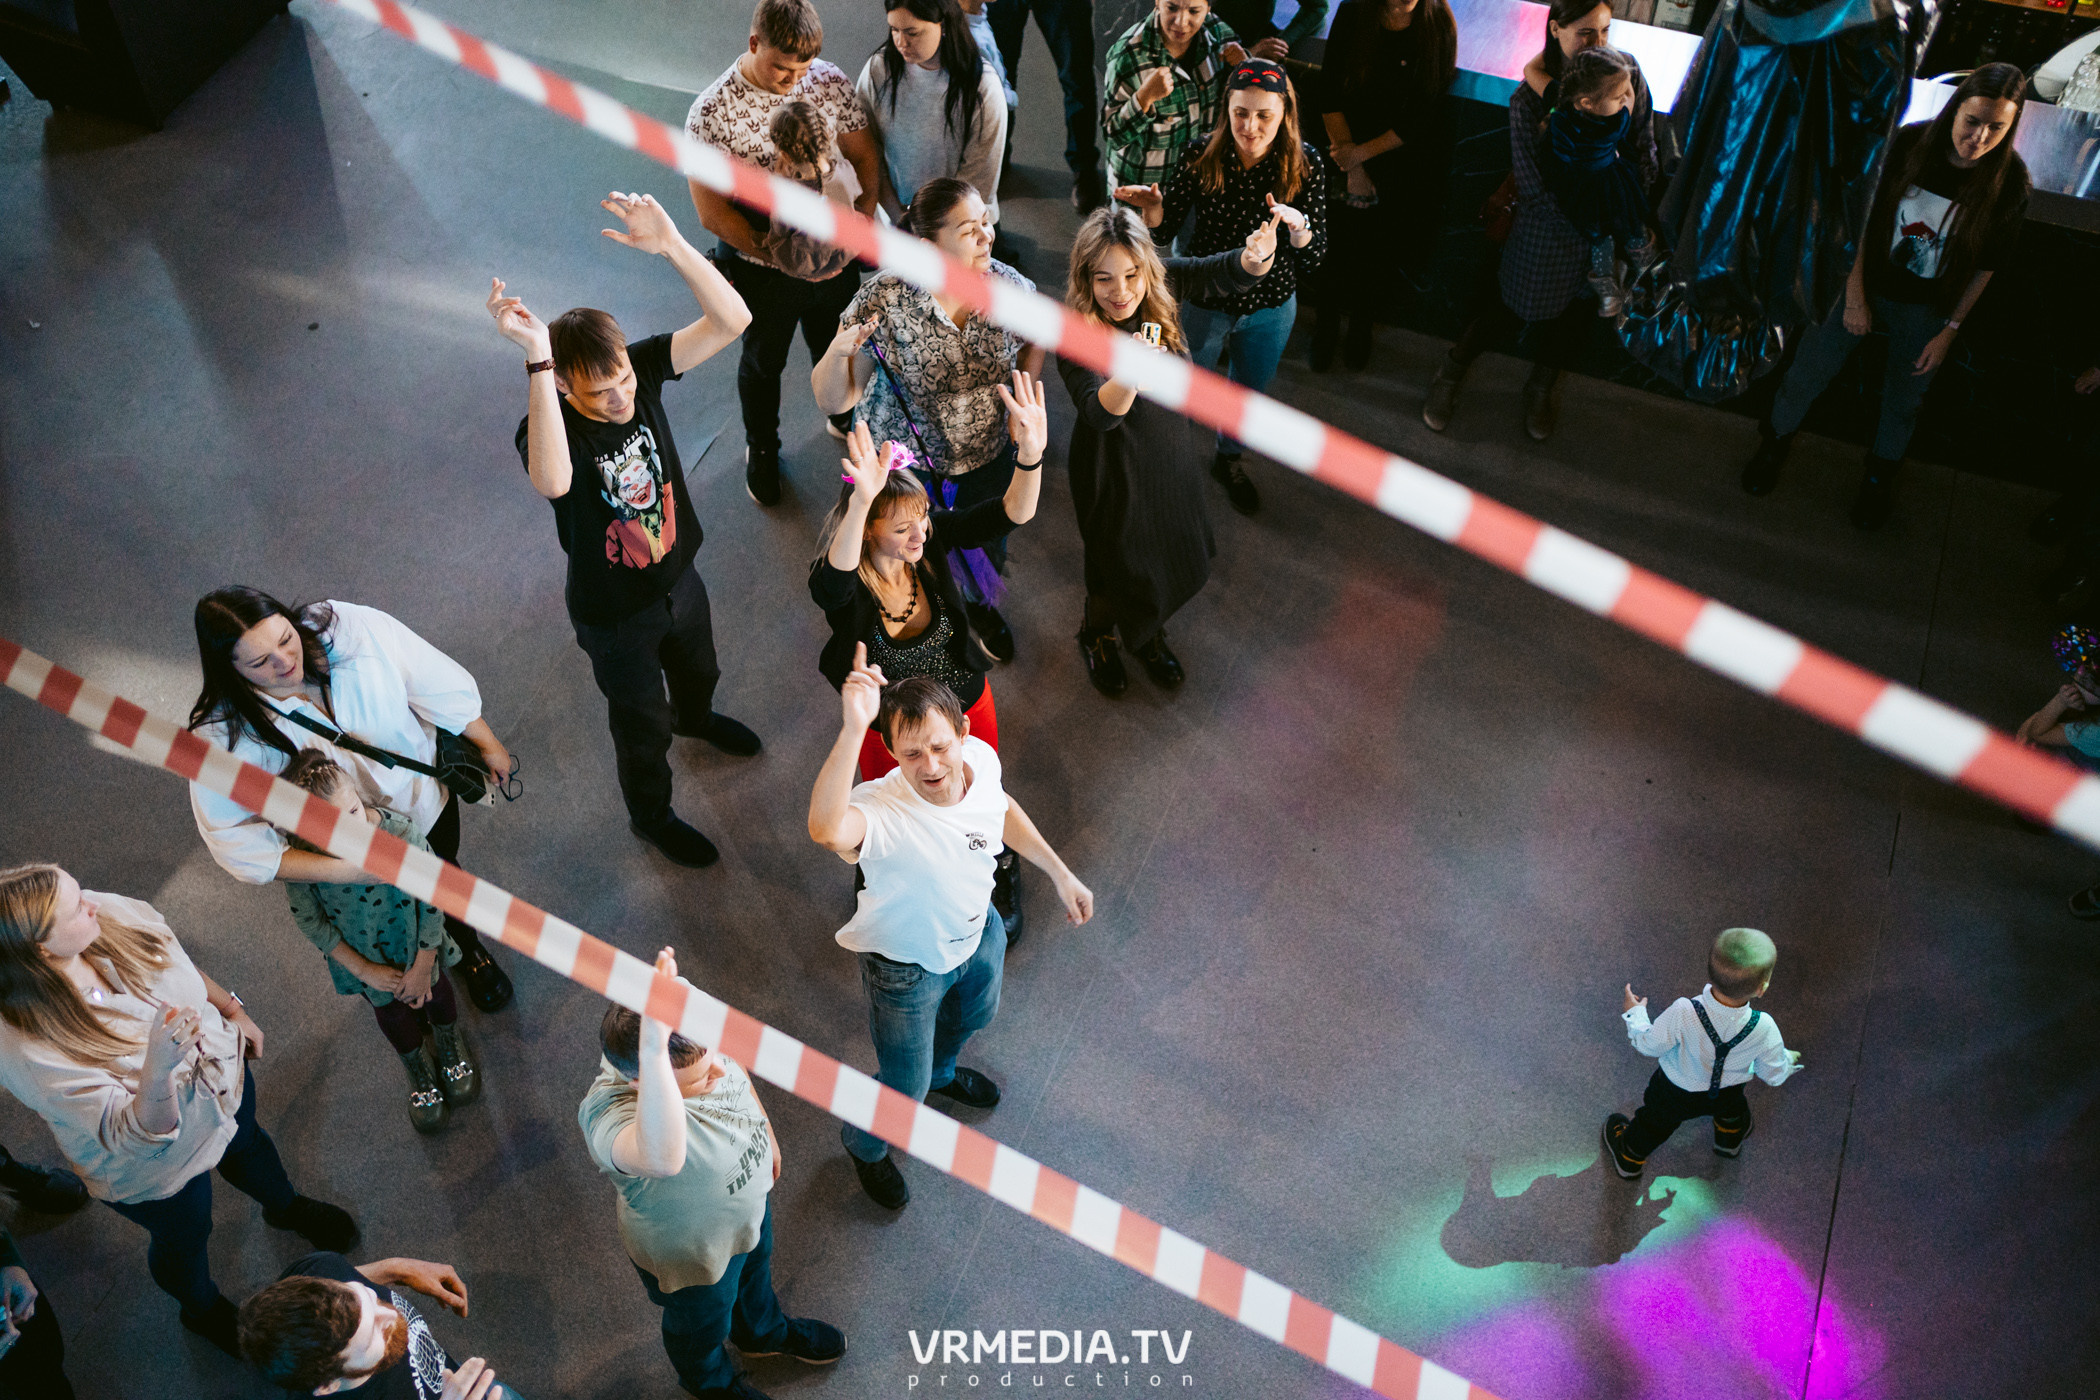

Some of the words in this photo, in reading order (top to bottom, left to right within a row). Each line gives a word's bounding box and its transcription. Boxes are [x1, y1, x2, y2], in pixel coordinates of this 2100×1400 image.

[739, 1117, 766, 1171] UNDER
[726, 1164, 753, 1196] THE
[409, 1355, 427, 1400] ORLD
